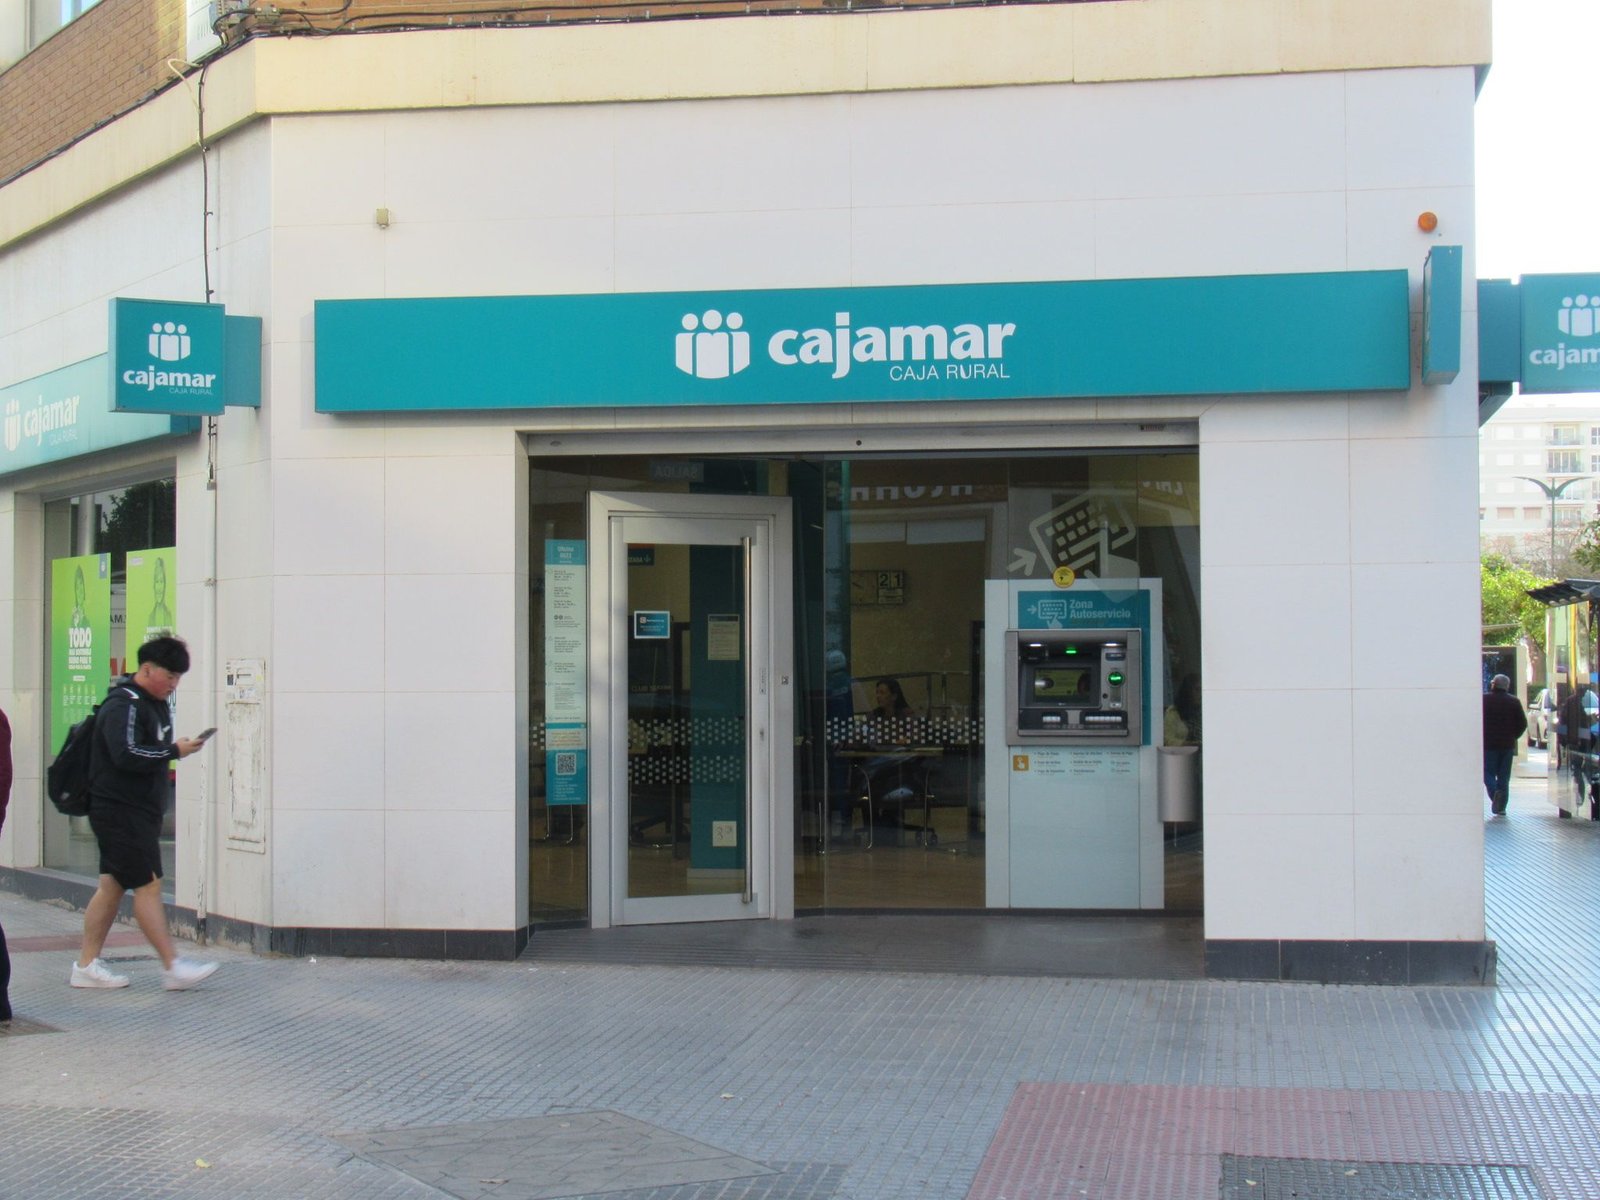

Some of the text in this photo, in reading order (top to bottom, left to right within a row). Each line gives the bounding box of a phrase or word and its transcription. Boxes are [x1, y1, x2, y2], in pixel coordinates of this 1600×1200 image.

[768, 312, 1016, 379] cajamar
[1530, 342, 1600, 370] cajam
[123, 365, 216, 391] cajamar
[889, 364, 1010, 381] CAJA RURAL
[169, 387, 213, 396] CAJA RURAL
[24, 394, 80, 447] cajamar
[1069, 600, 1094, 609] Zona
[1069, 608, 1131, 619] Autoservicio
[68, 627, 92, 648] TODO
